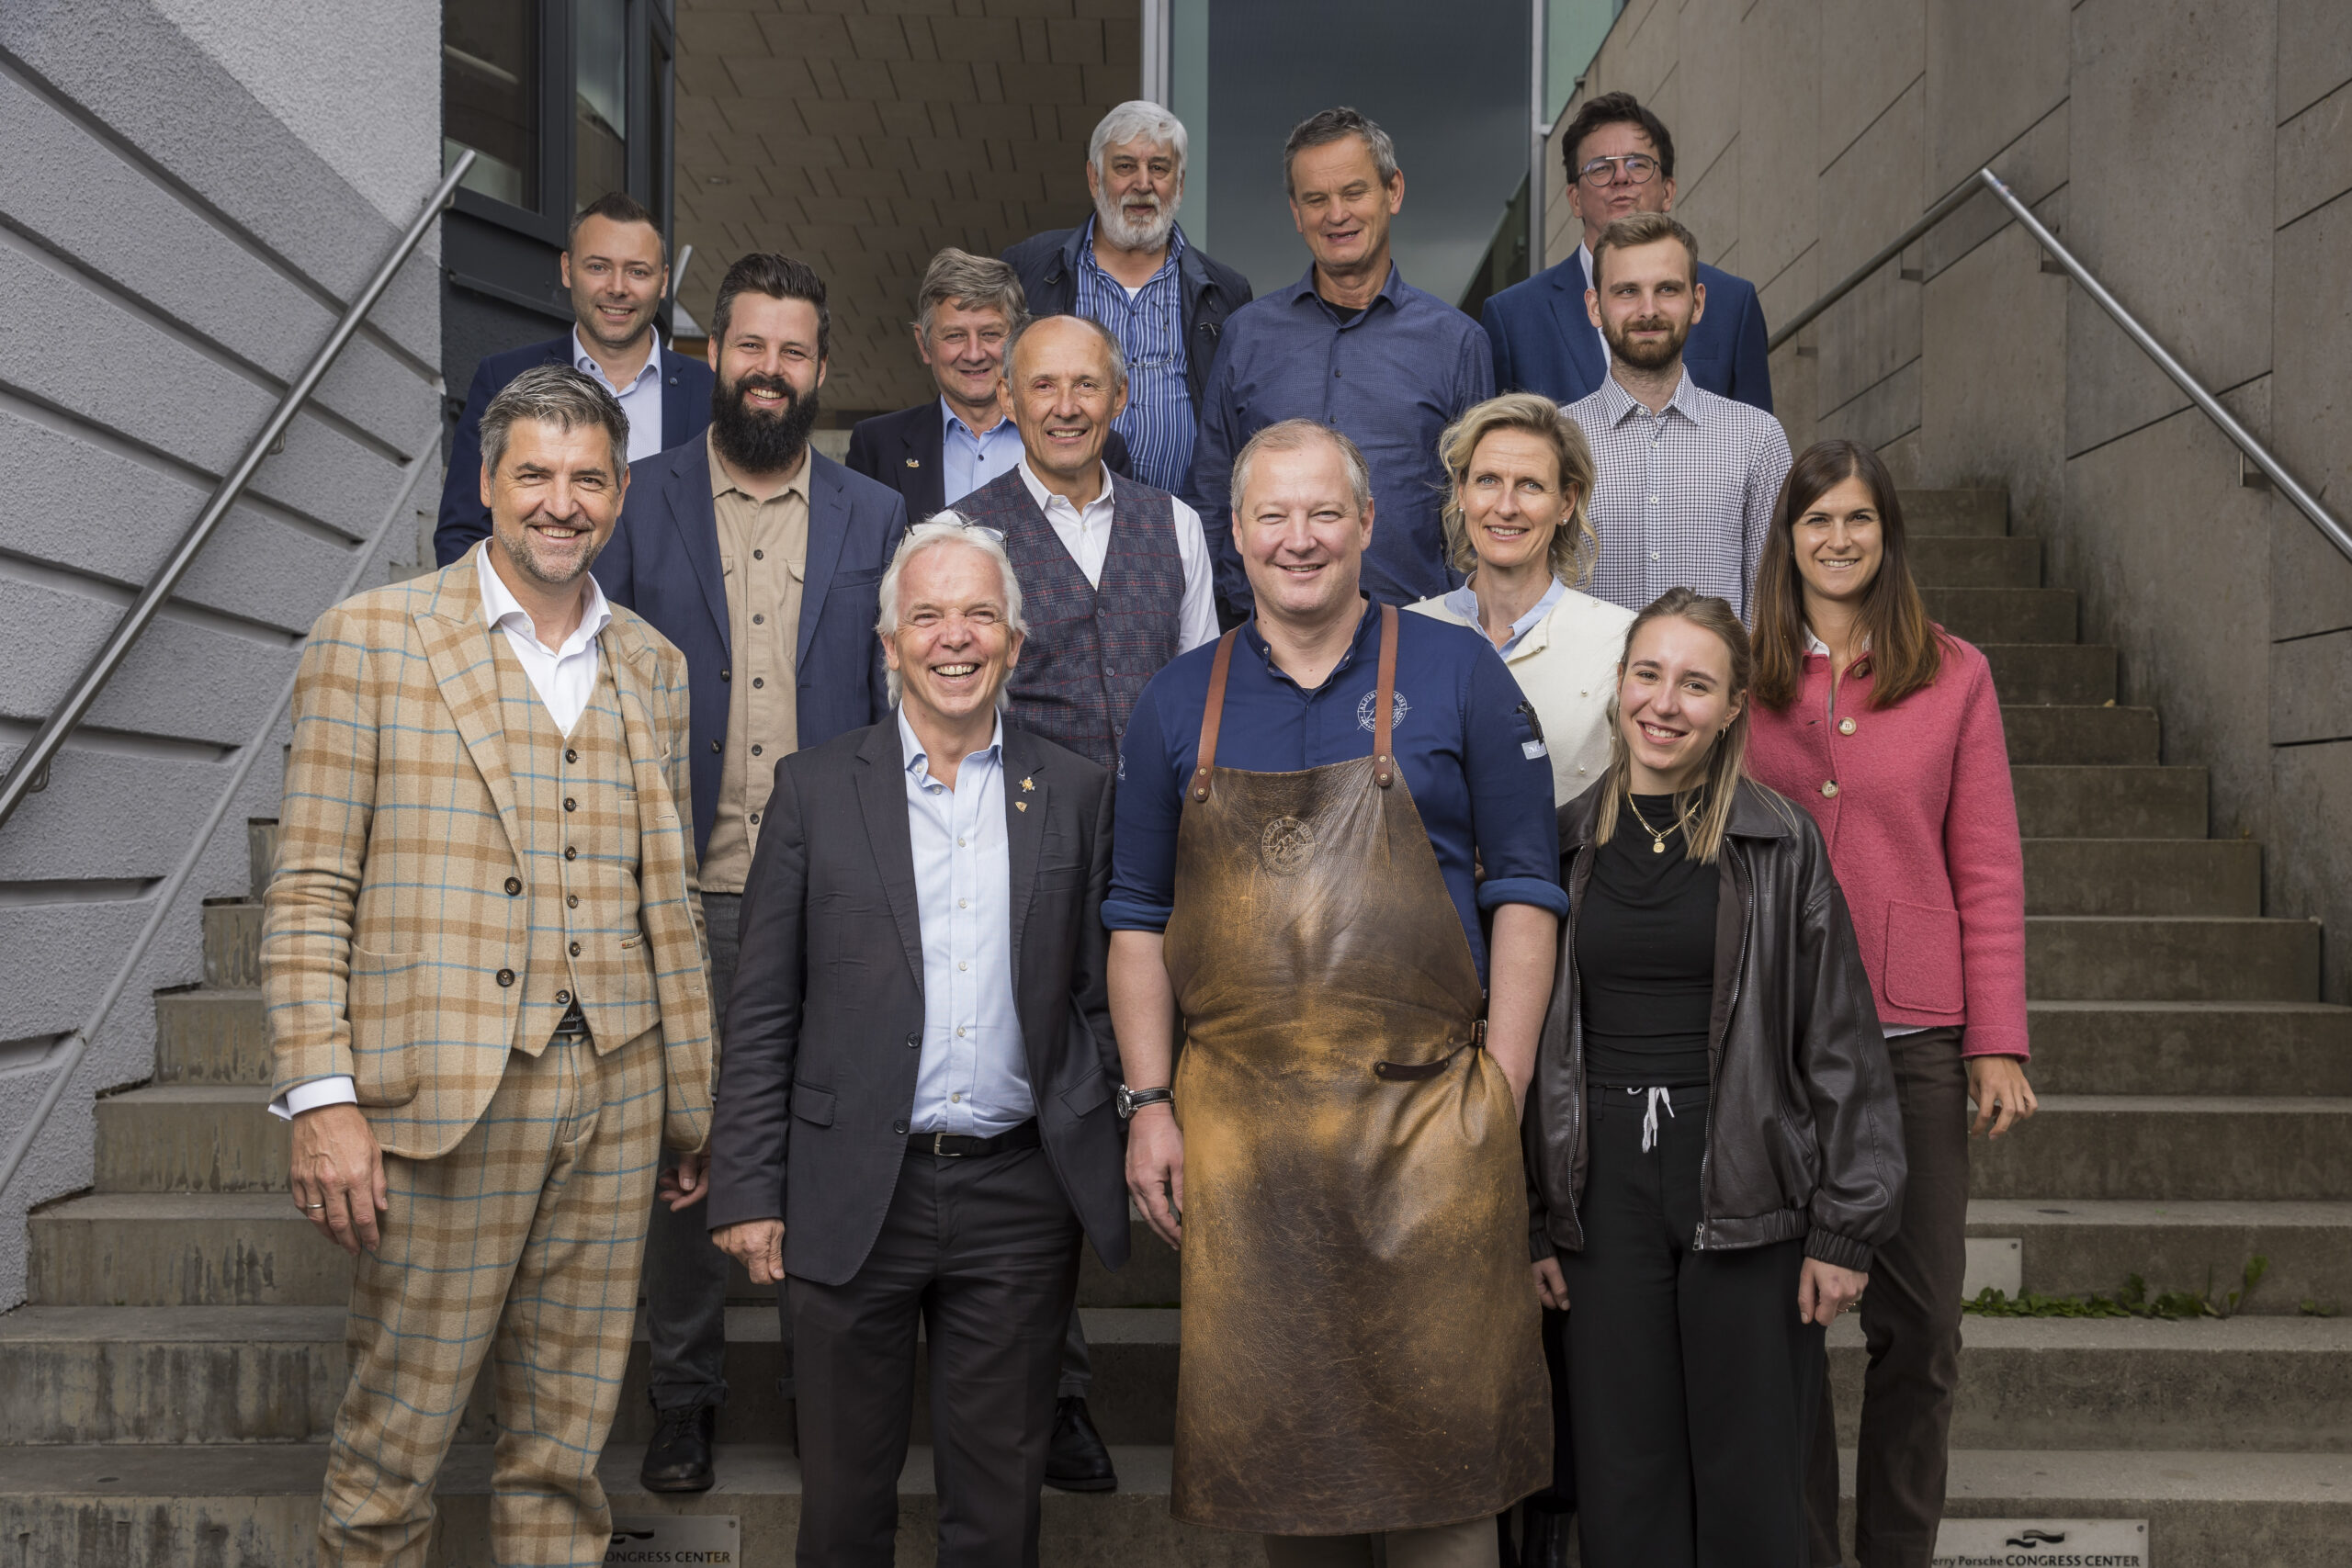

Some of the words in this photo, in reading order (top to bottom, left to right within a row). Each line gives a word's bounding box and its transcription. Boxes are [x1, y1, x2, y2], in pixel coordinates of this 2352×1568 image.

[605, 1551, 671, 1563] ONGRESS
[674, 1551, 731, 1563] CENTER
[1932, 1557, 1955, 1568] erry
[1958, 1555, 2003, 1566] Porsche
[2006, 1554, 2081, 1566] CONGRESS
[2085, 1554, 2140, 1567] CENTER
